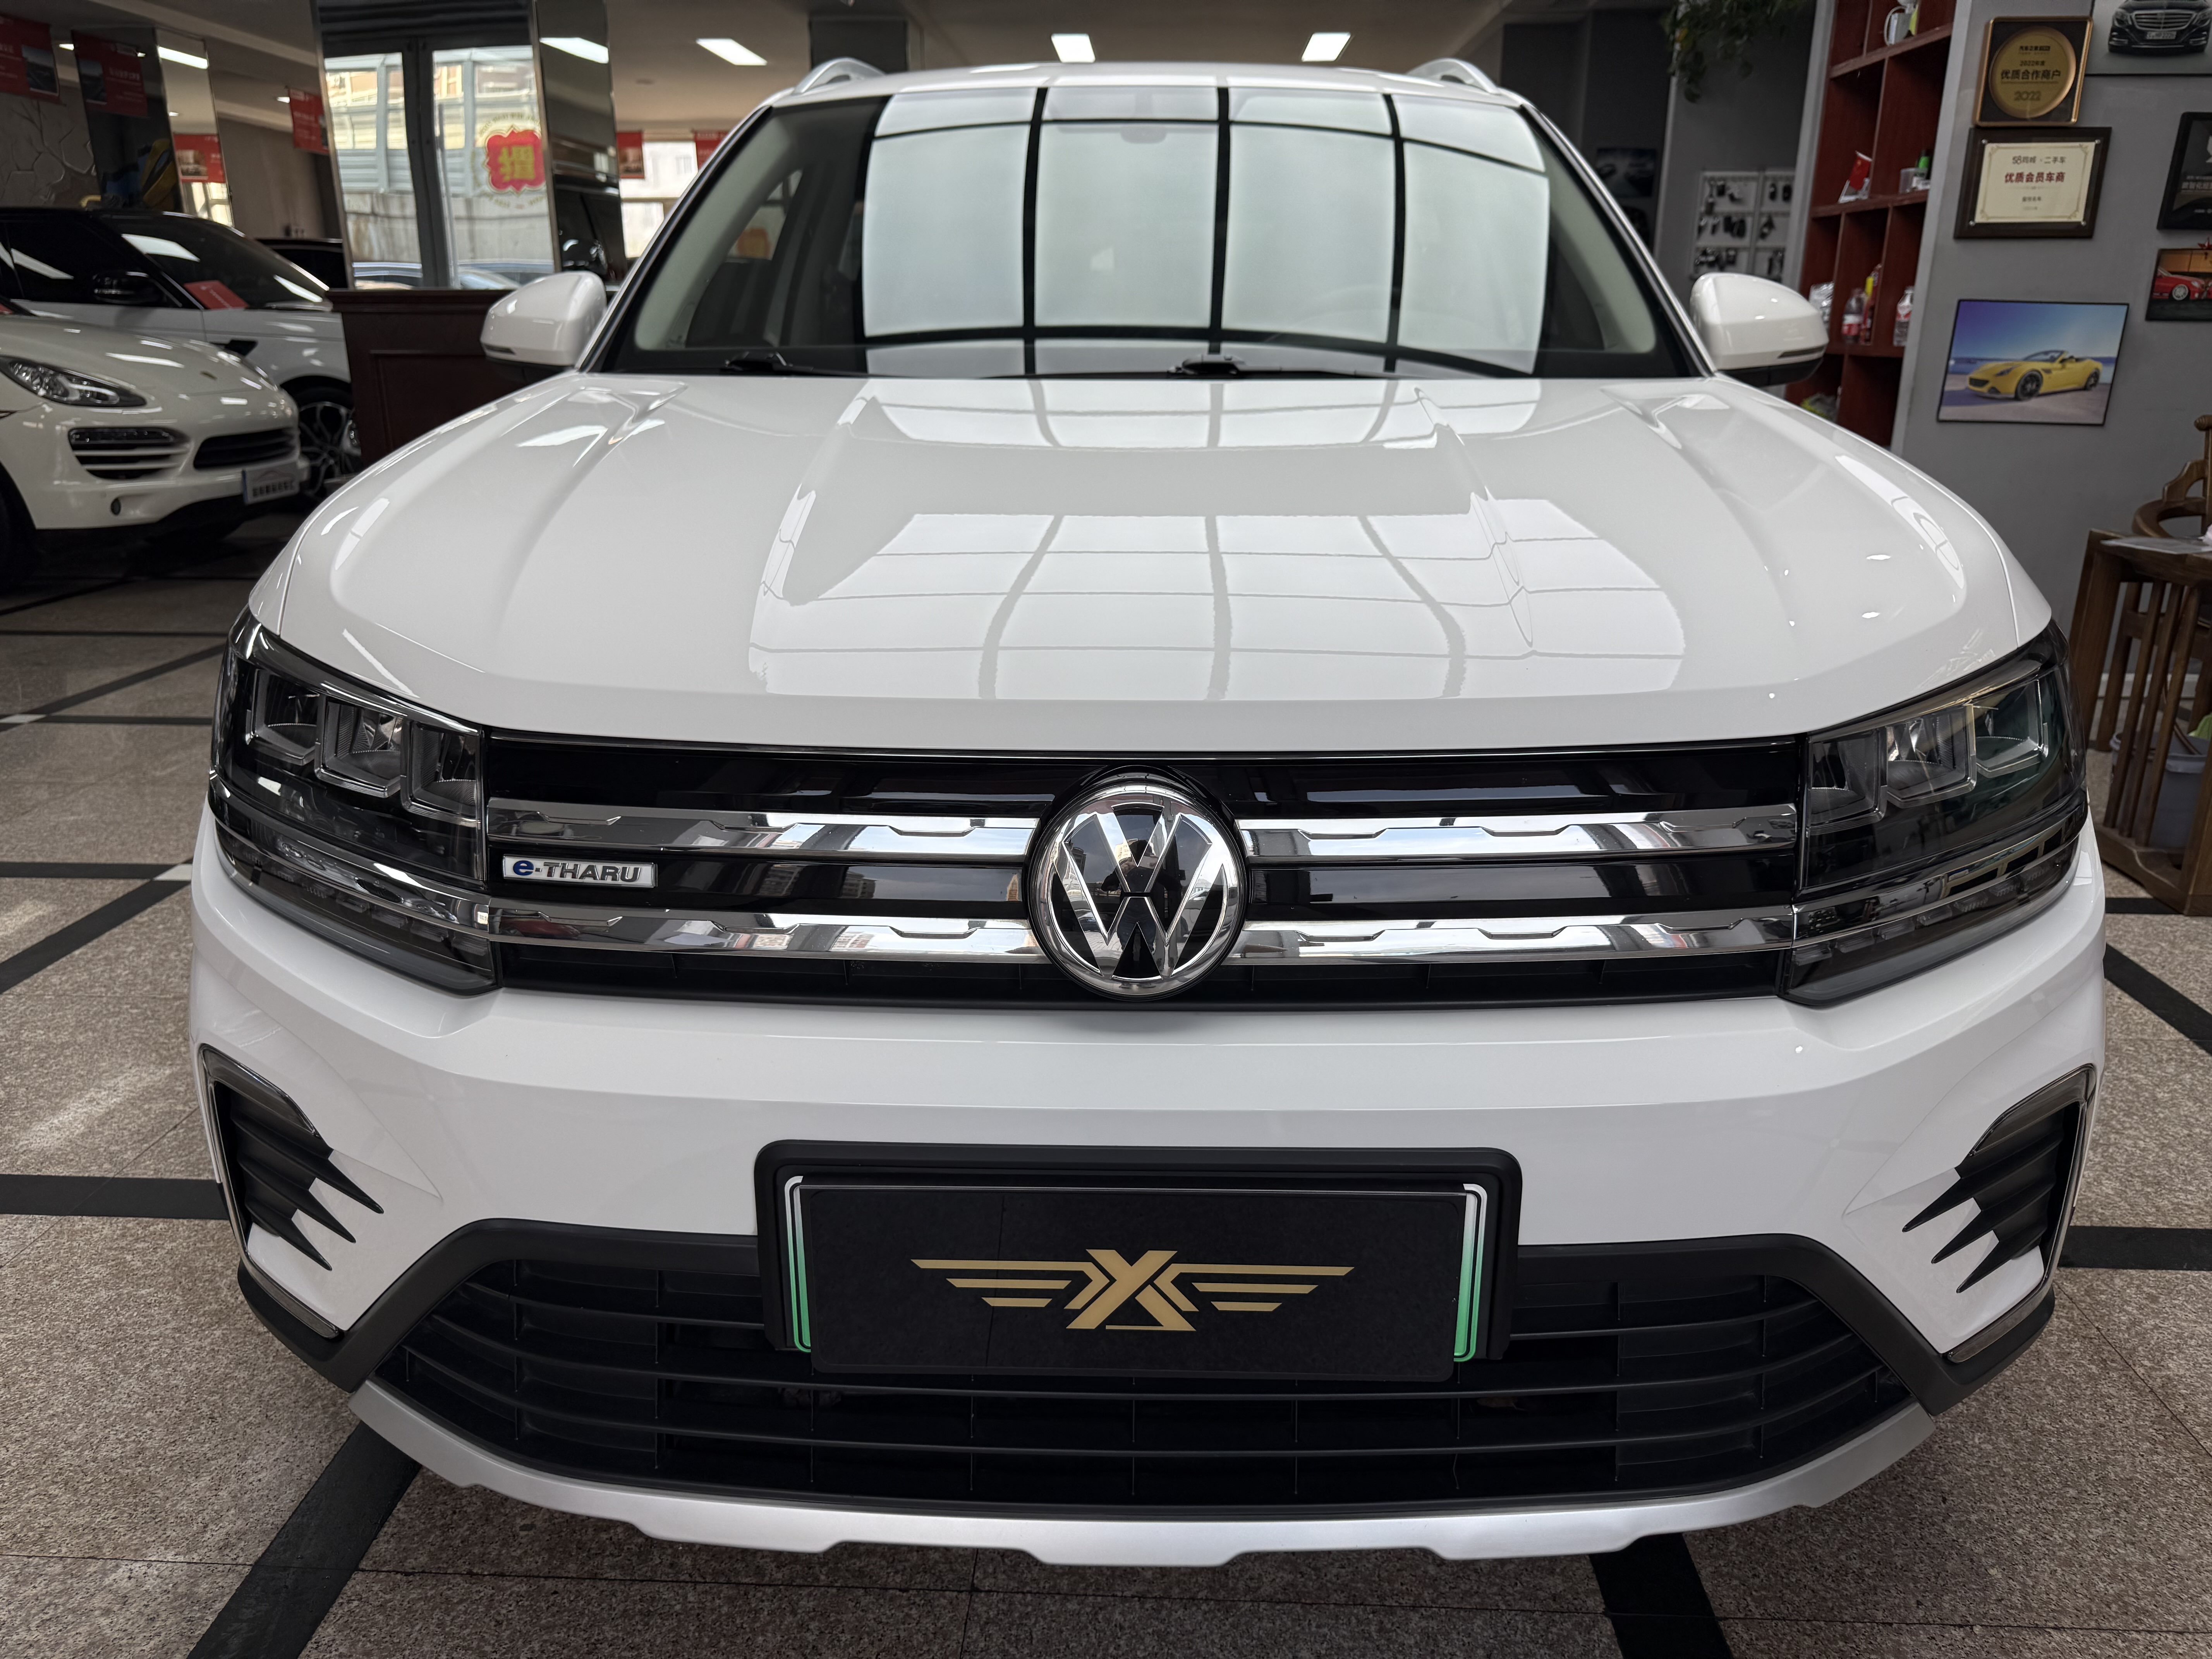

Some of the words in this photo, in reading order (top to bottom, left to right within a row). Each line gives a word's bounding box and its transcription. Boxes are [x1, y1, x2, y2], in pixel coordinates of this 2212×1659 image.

[2001, 69, 2061, 80] 优质合作商户
[2014, 91, 2041, 101] 2022
[2004, 172, 2065, 183] 优质会员车商
[513, 860, 641, 882] e-THARU
